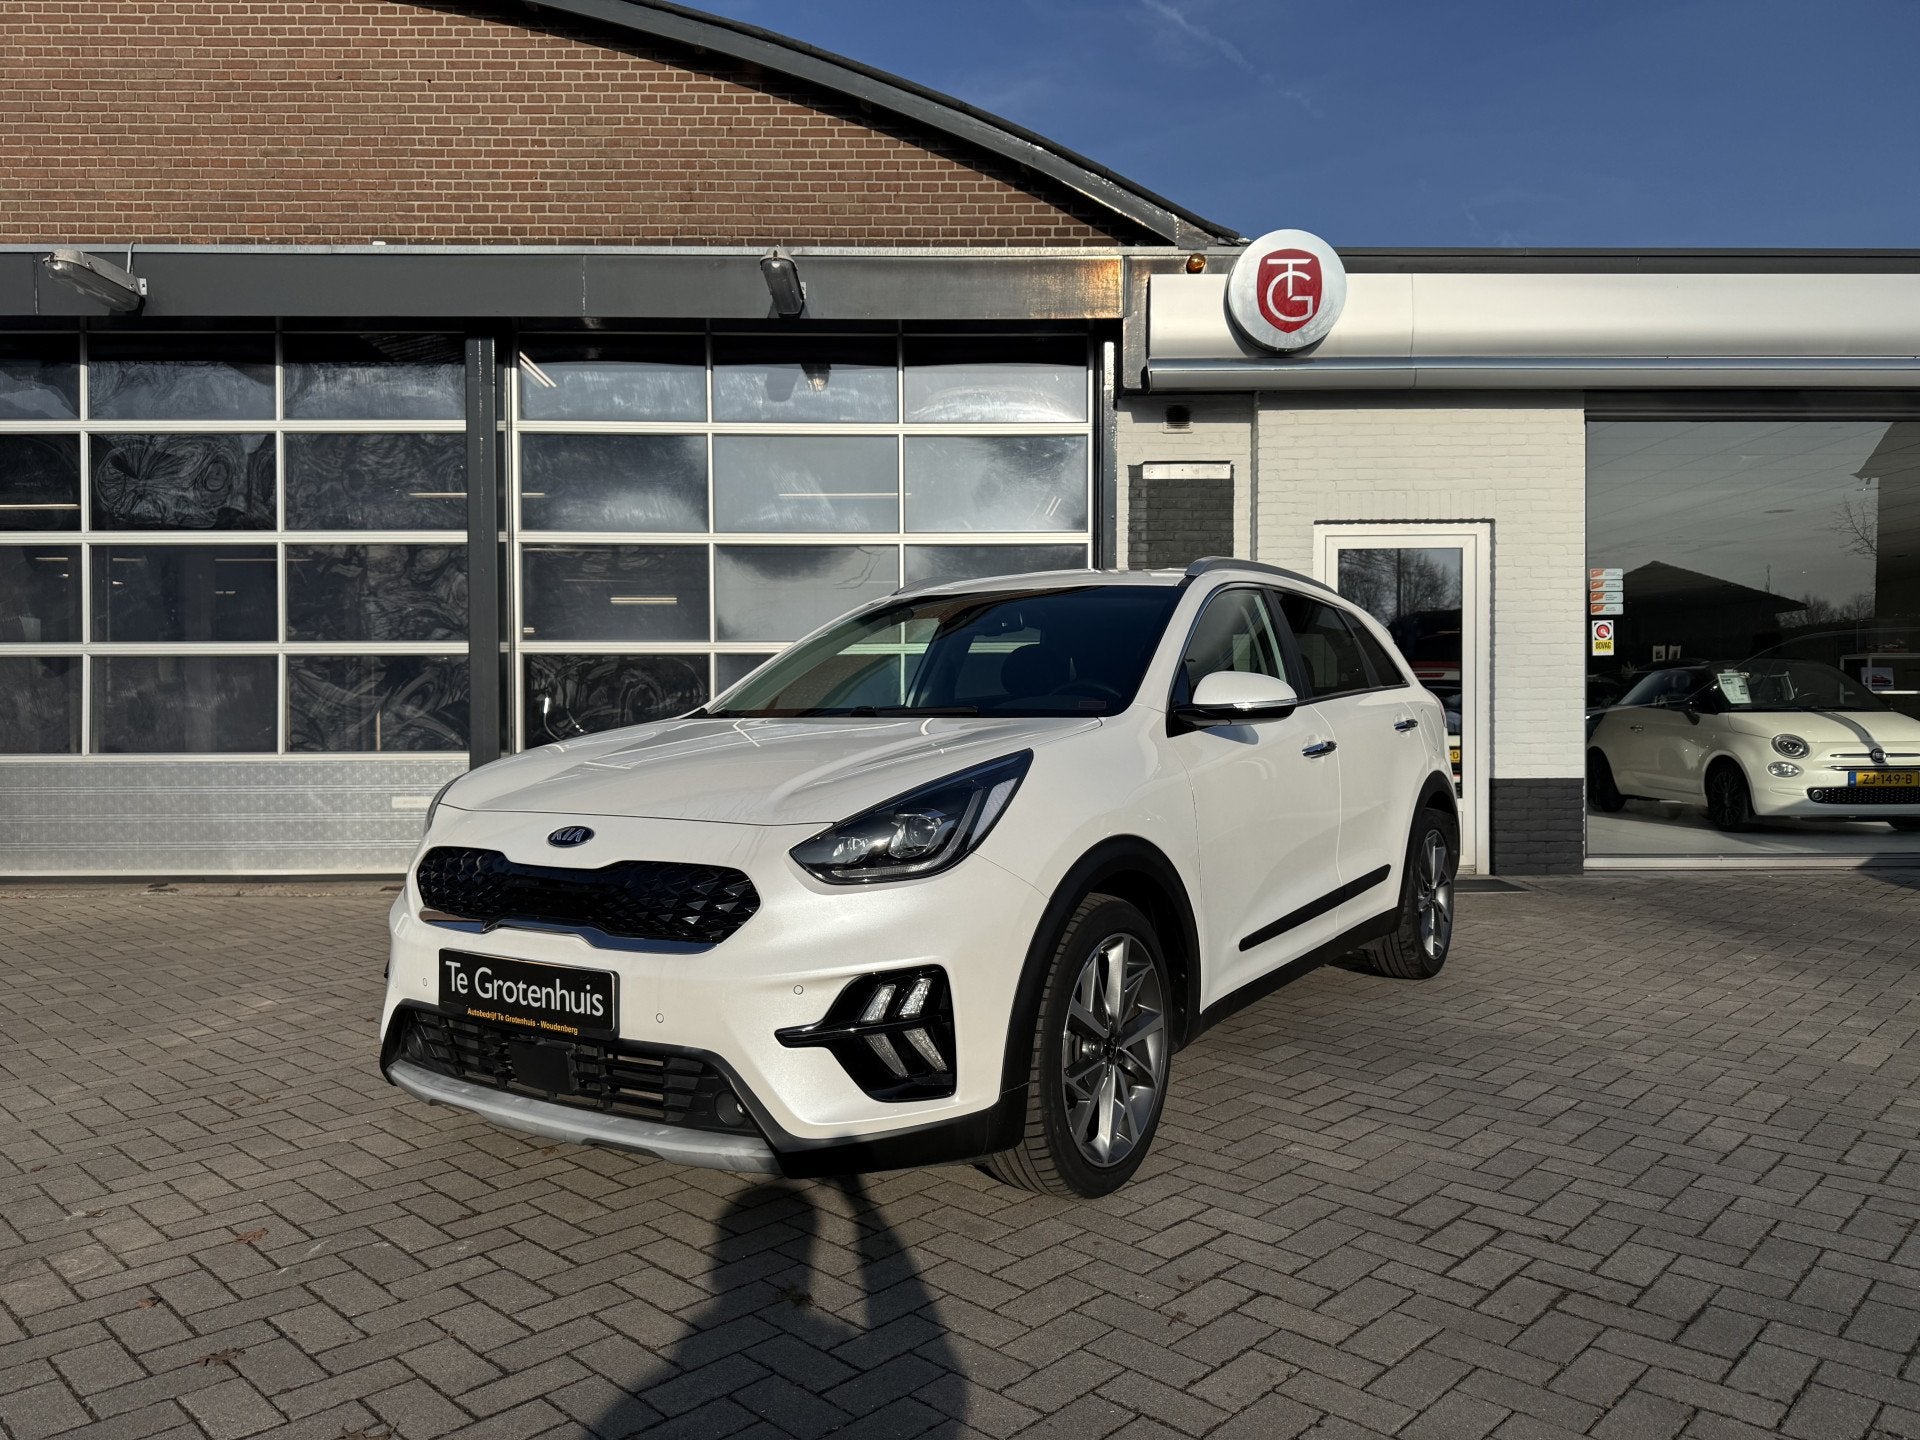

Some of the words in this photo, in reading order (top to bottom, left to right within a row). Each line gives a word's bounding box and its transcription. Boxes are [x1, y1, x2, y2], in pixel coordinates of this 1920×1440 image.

[1595, 641, 1611, 650] BOVAG
[1862, 774, 1912, 785] ZJ-149-B
[551, 828, 585, 842] KIA
[446, 960, 468, 994] Te
[475, 967, 604, 1016] Grotenhuis
[467, 1008, 497, 1020] Autobedrijf
[498, 1012, 505, 1021] Te
[505, 1014, 536, 1026] Grotenhuis
[540, 1021, 578, 1035] Woudenberg
